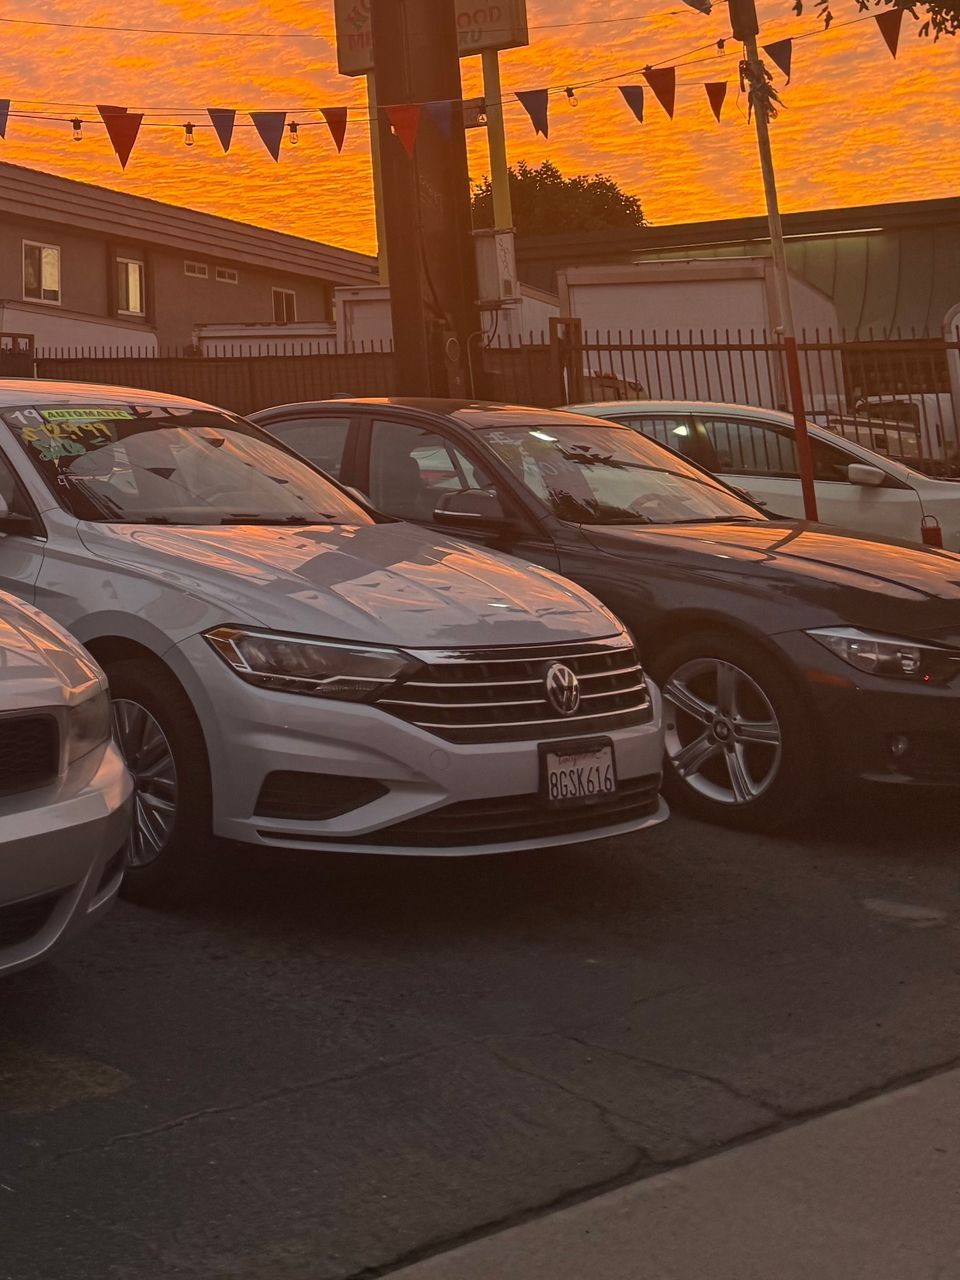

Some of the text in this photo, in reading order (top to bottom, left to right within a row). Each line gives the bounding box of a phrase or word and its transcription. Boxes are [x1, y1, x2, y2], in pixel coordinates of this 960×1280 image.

[456, 5, 502, 28] OOD
[11, 409, 45, 425] 19
[47, 410, 129, 418] AUTOMATIC
[550, 764, 613, 799] 8GSK616
